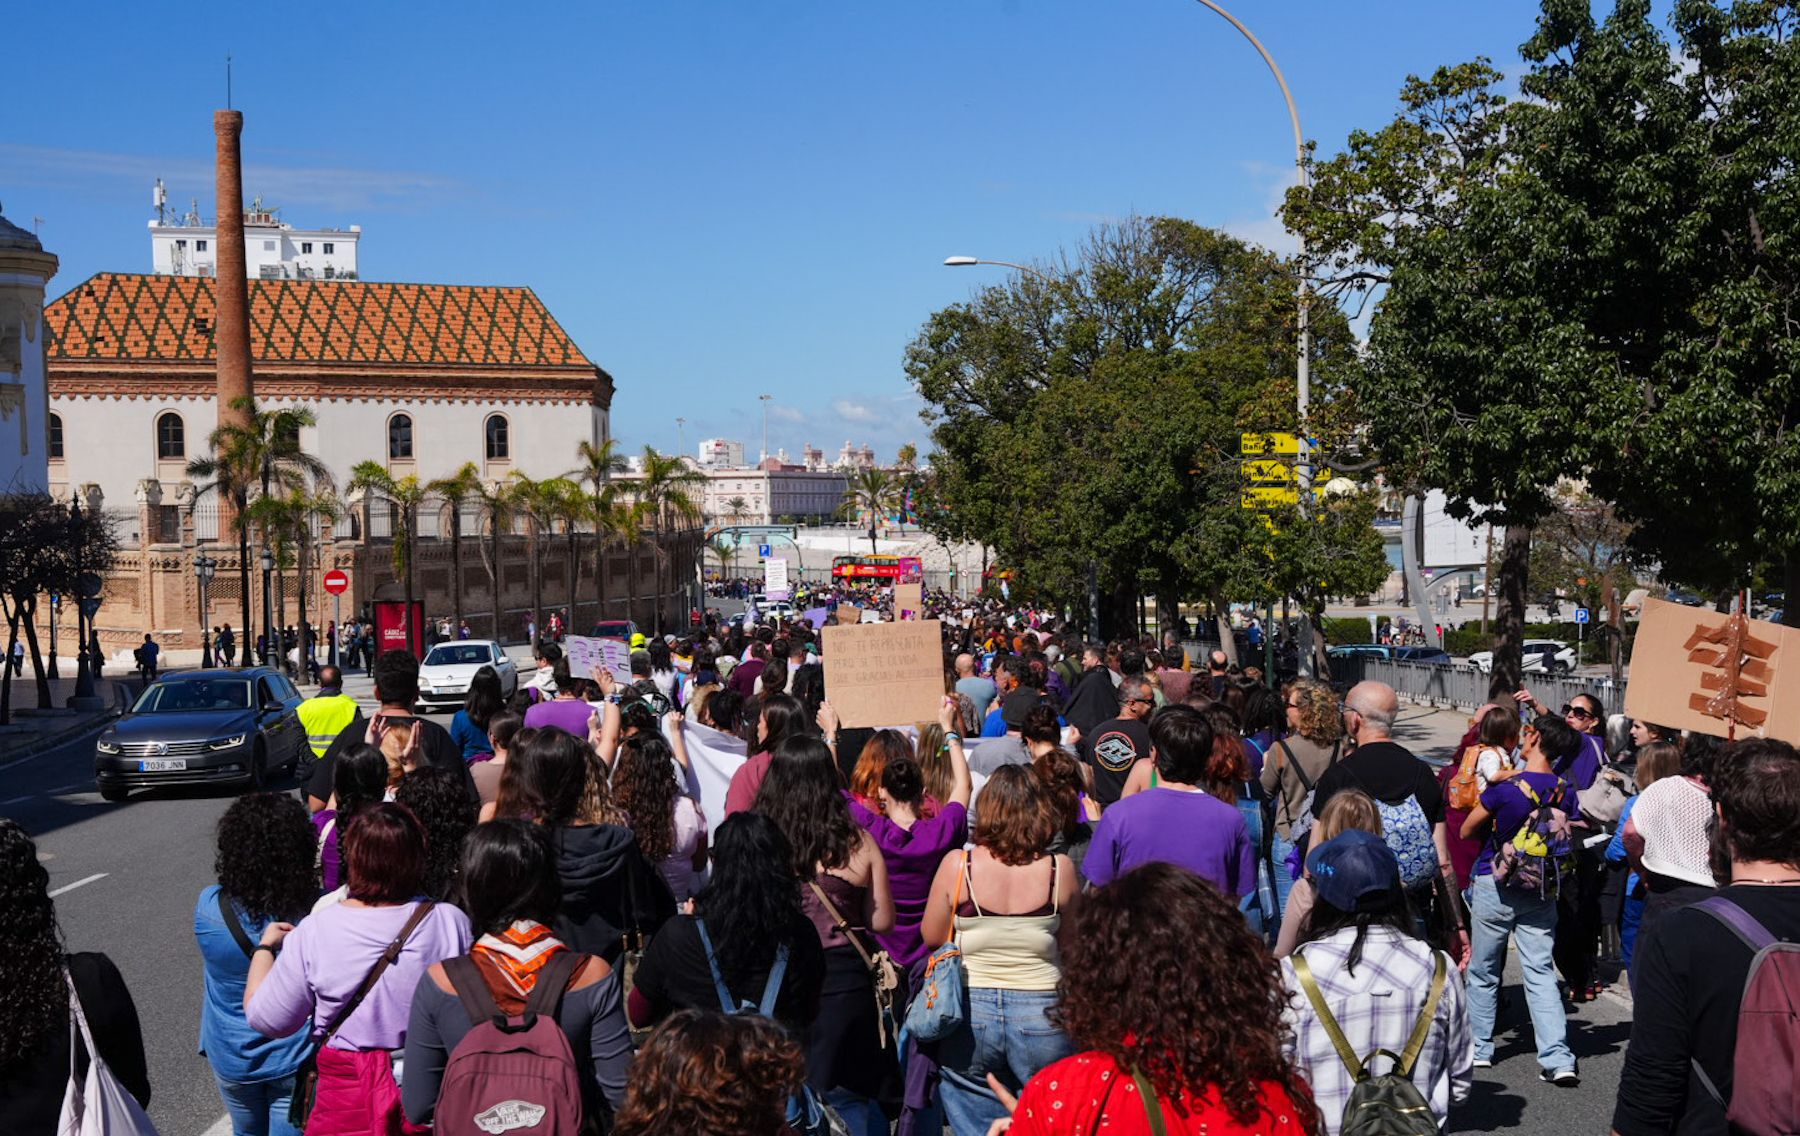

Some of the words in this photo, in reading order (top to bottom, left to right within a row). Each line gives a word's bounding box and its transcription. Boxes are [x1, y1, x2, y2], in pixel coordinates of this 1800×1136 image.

[833, 640, 846, 653] NO
[856, 640, 866, 653] TE
[145, 761, 166, 770] 7036
[168, 760, 184, 769] JNN
